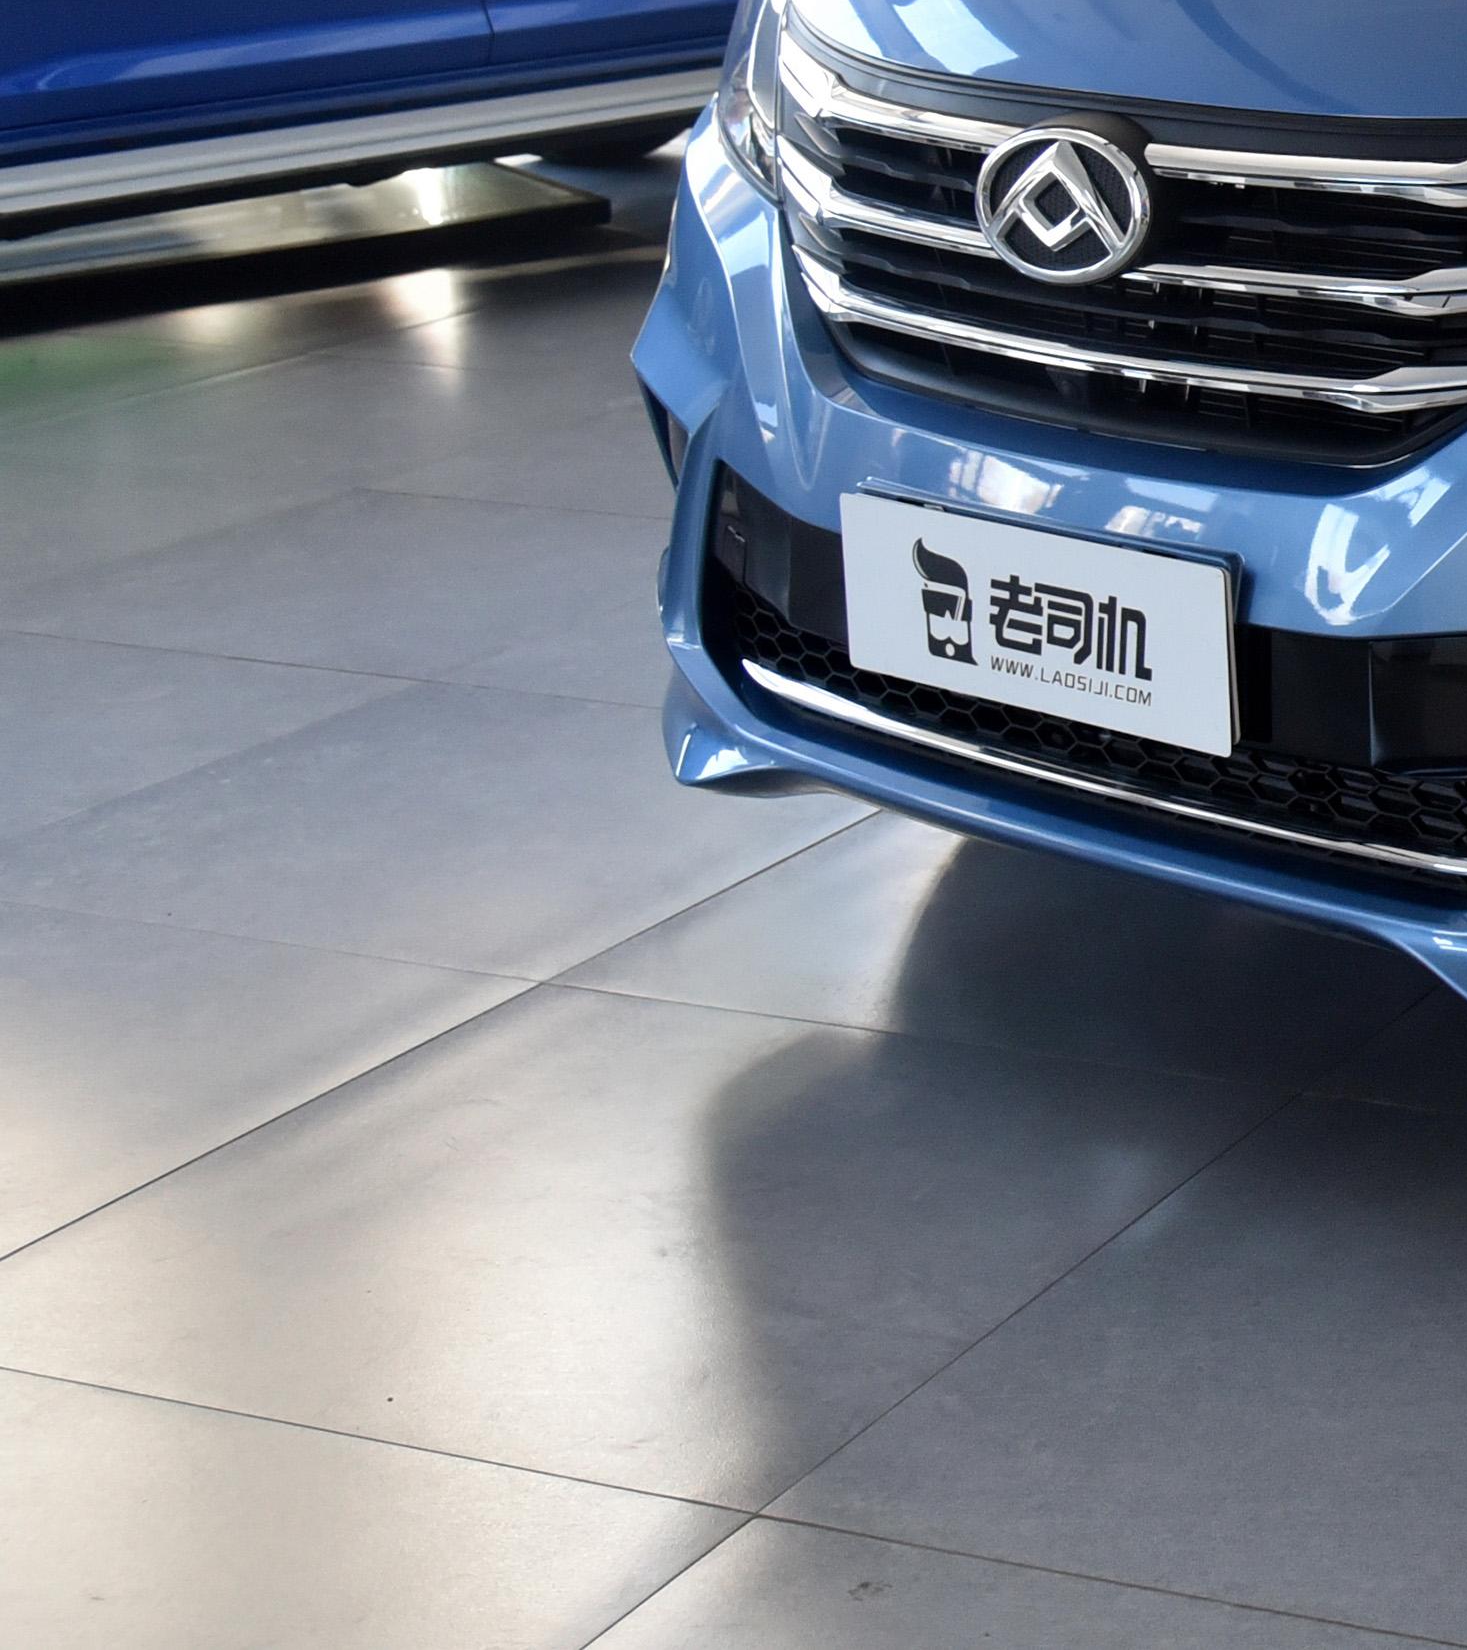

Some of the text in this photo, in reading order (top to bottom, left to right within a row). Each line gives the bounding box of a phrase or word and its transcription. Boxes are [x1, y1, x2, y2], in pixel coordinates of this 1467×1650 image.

[989, 573, 1152, 681] 老司机
[990, 656, 1153, 707] WWW.LAOSIJI.COM
